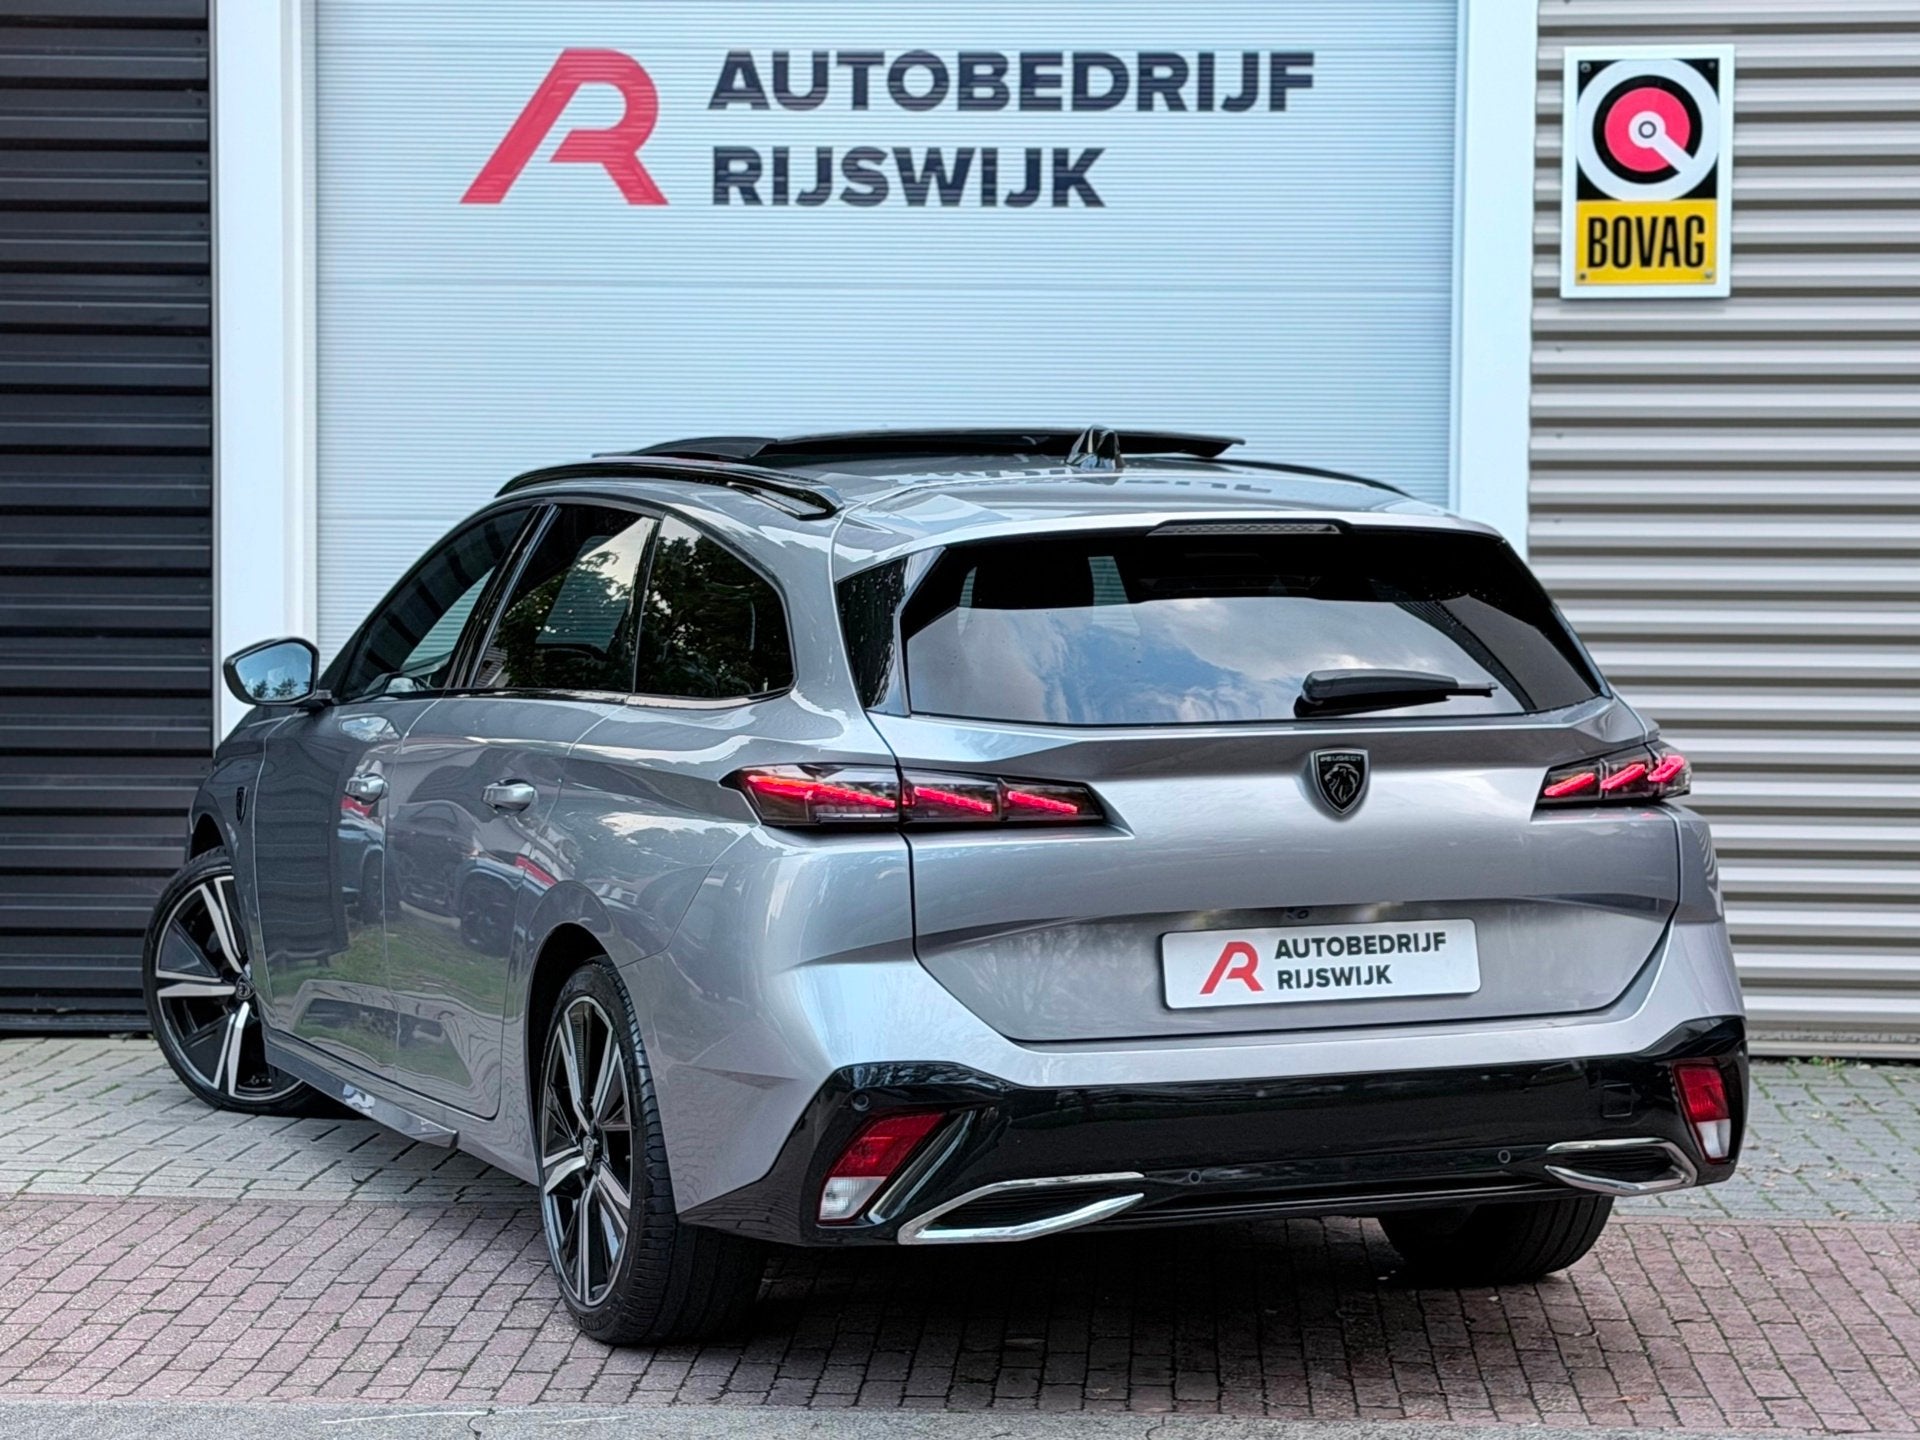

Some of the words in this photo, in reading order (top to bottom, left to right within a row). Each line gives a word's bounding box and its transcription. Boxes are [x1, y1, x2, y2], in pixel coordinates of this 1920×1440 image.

[708, 50, 1314, 112] AUTOBEDRIJF
[712, 146, 1106, 208] RIJSWIJK
[1587, 215, 1705, 269] BOVAG
[1274, 932, 1446, 960] AUTOBEDRIJF
[1277, 964, 1392, 990] RIJSWIJK
